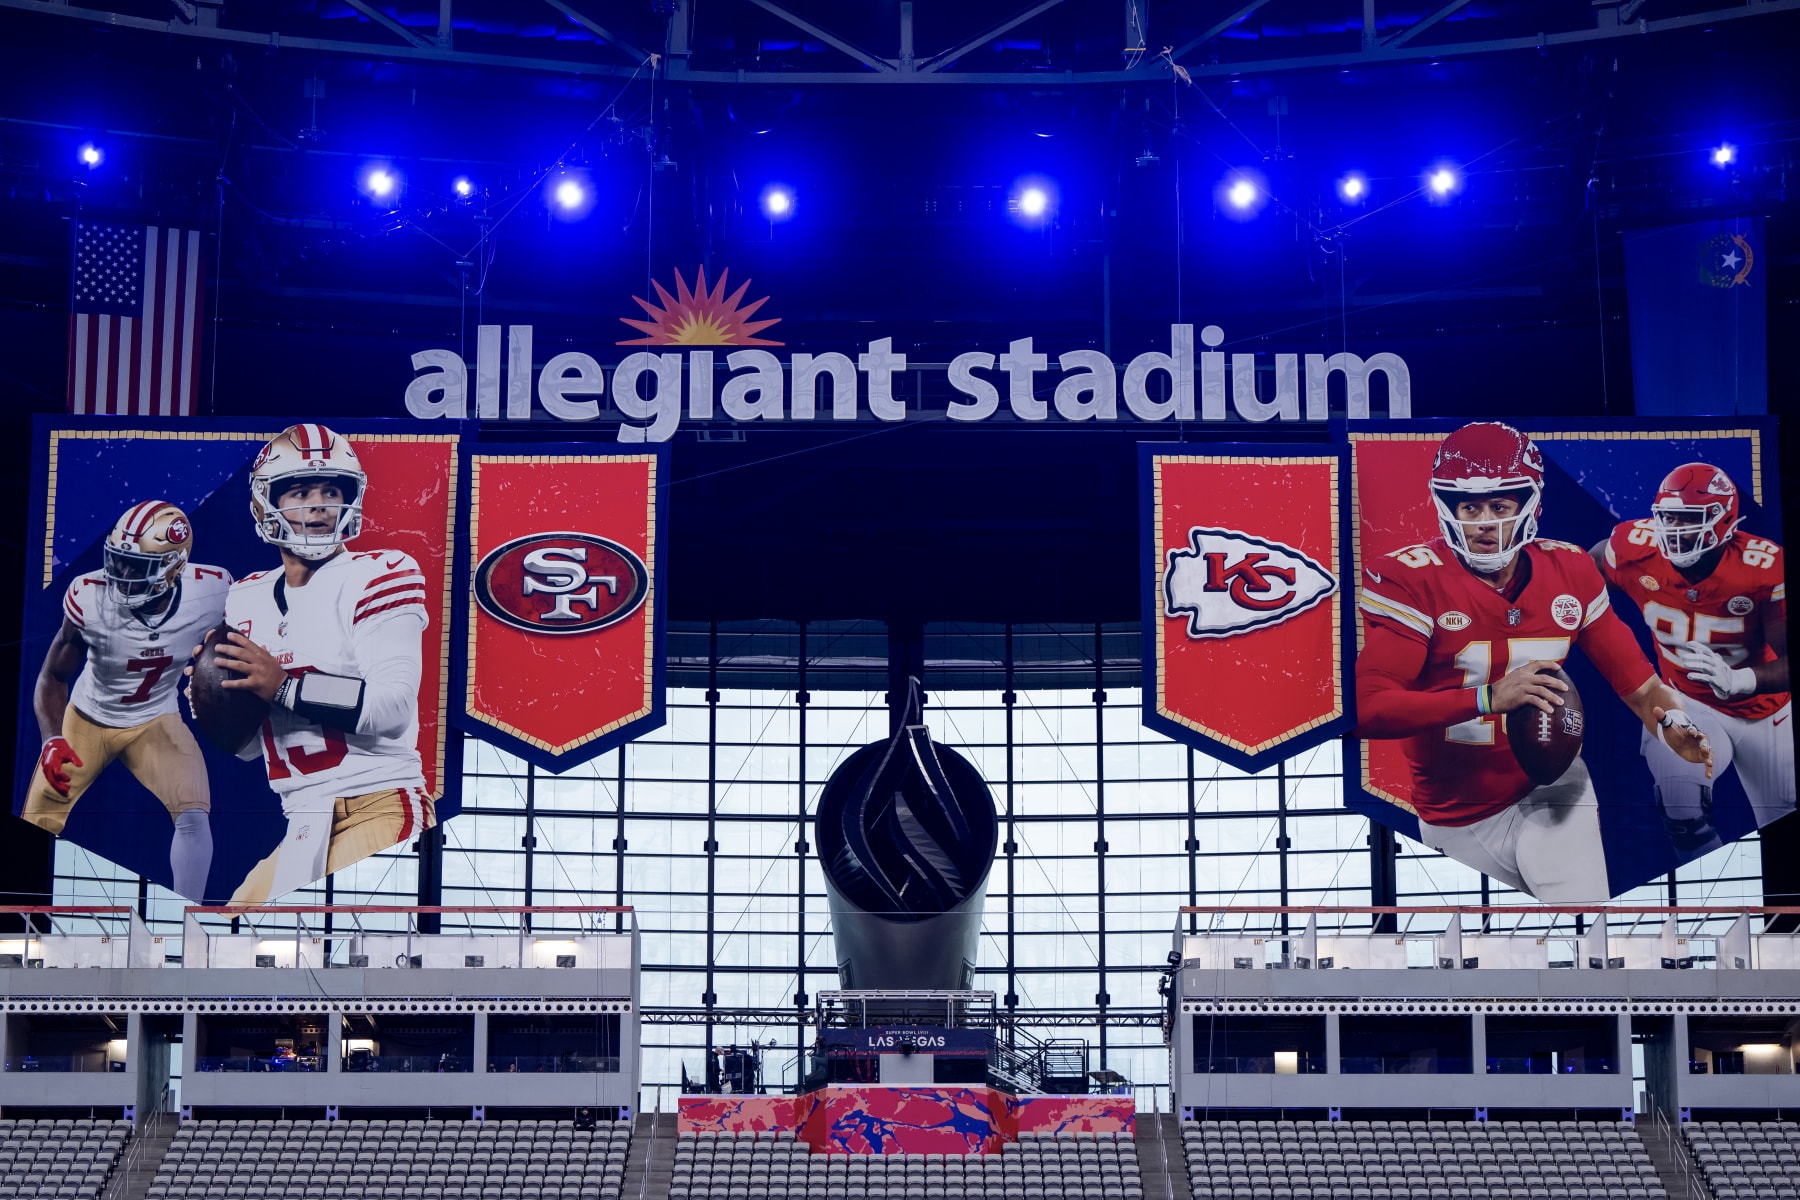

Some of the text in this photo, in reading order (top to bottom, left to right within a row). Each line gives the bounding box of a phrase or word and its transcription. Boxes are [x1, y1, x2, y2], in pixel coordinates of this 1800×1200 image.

[404, 324, 1412, 443] allegiant stadium
[523, 547, 617, 619] SF
[1203, 553, 1297, 611] KC
[1445, 616, 1464, 627] NKH
[1643, 600, 1749, 668] 95
[120, 655, 173, 704] 7
[868, 1036, 946, 1047] LAS EGAS
